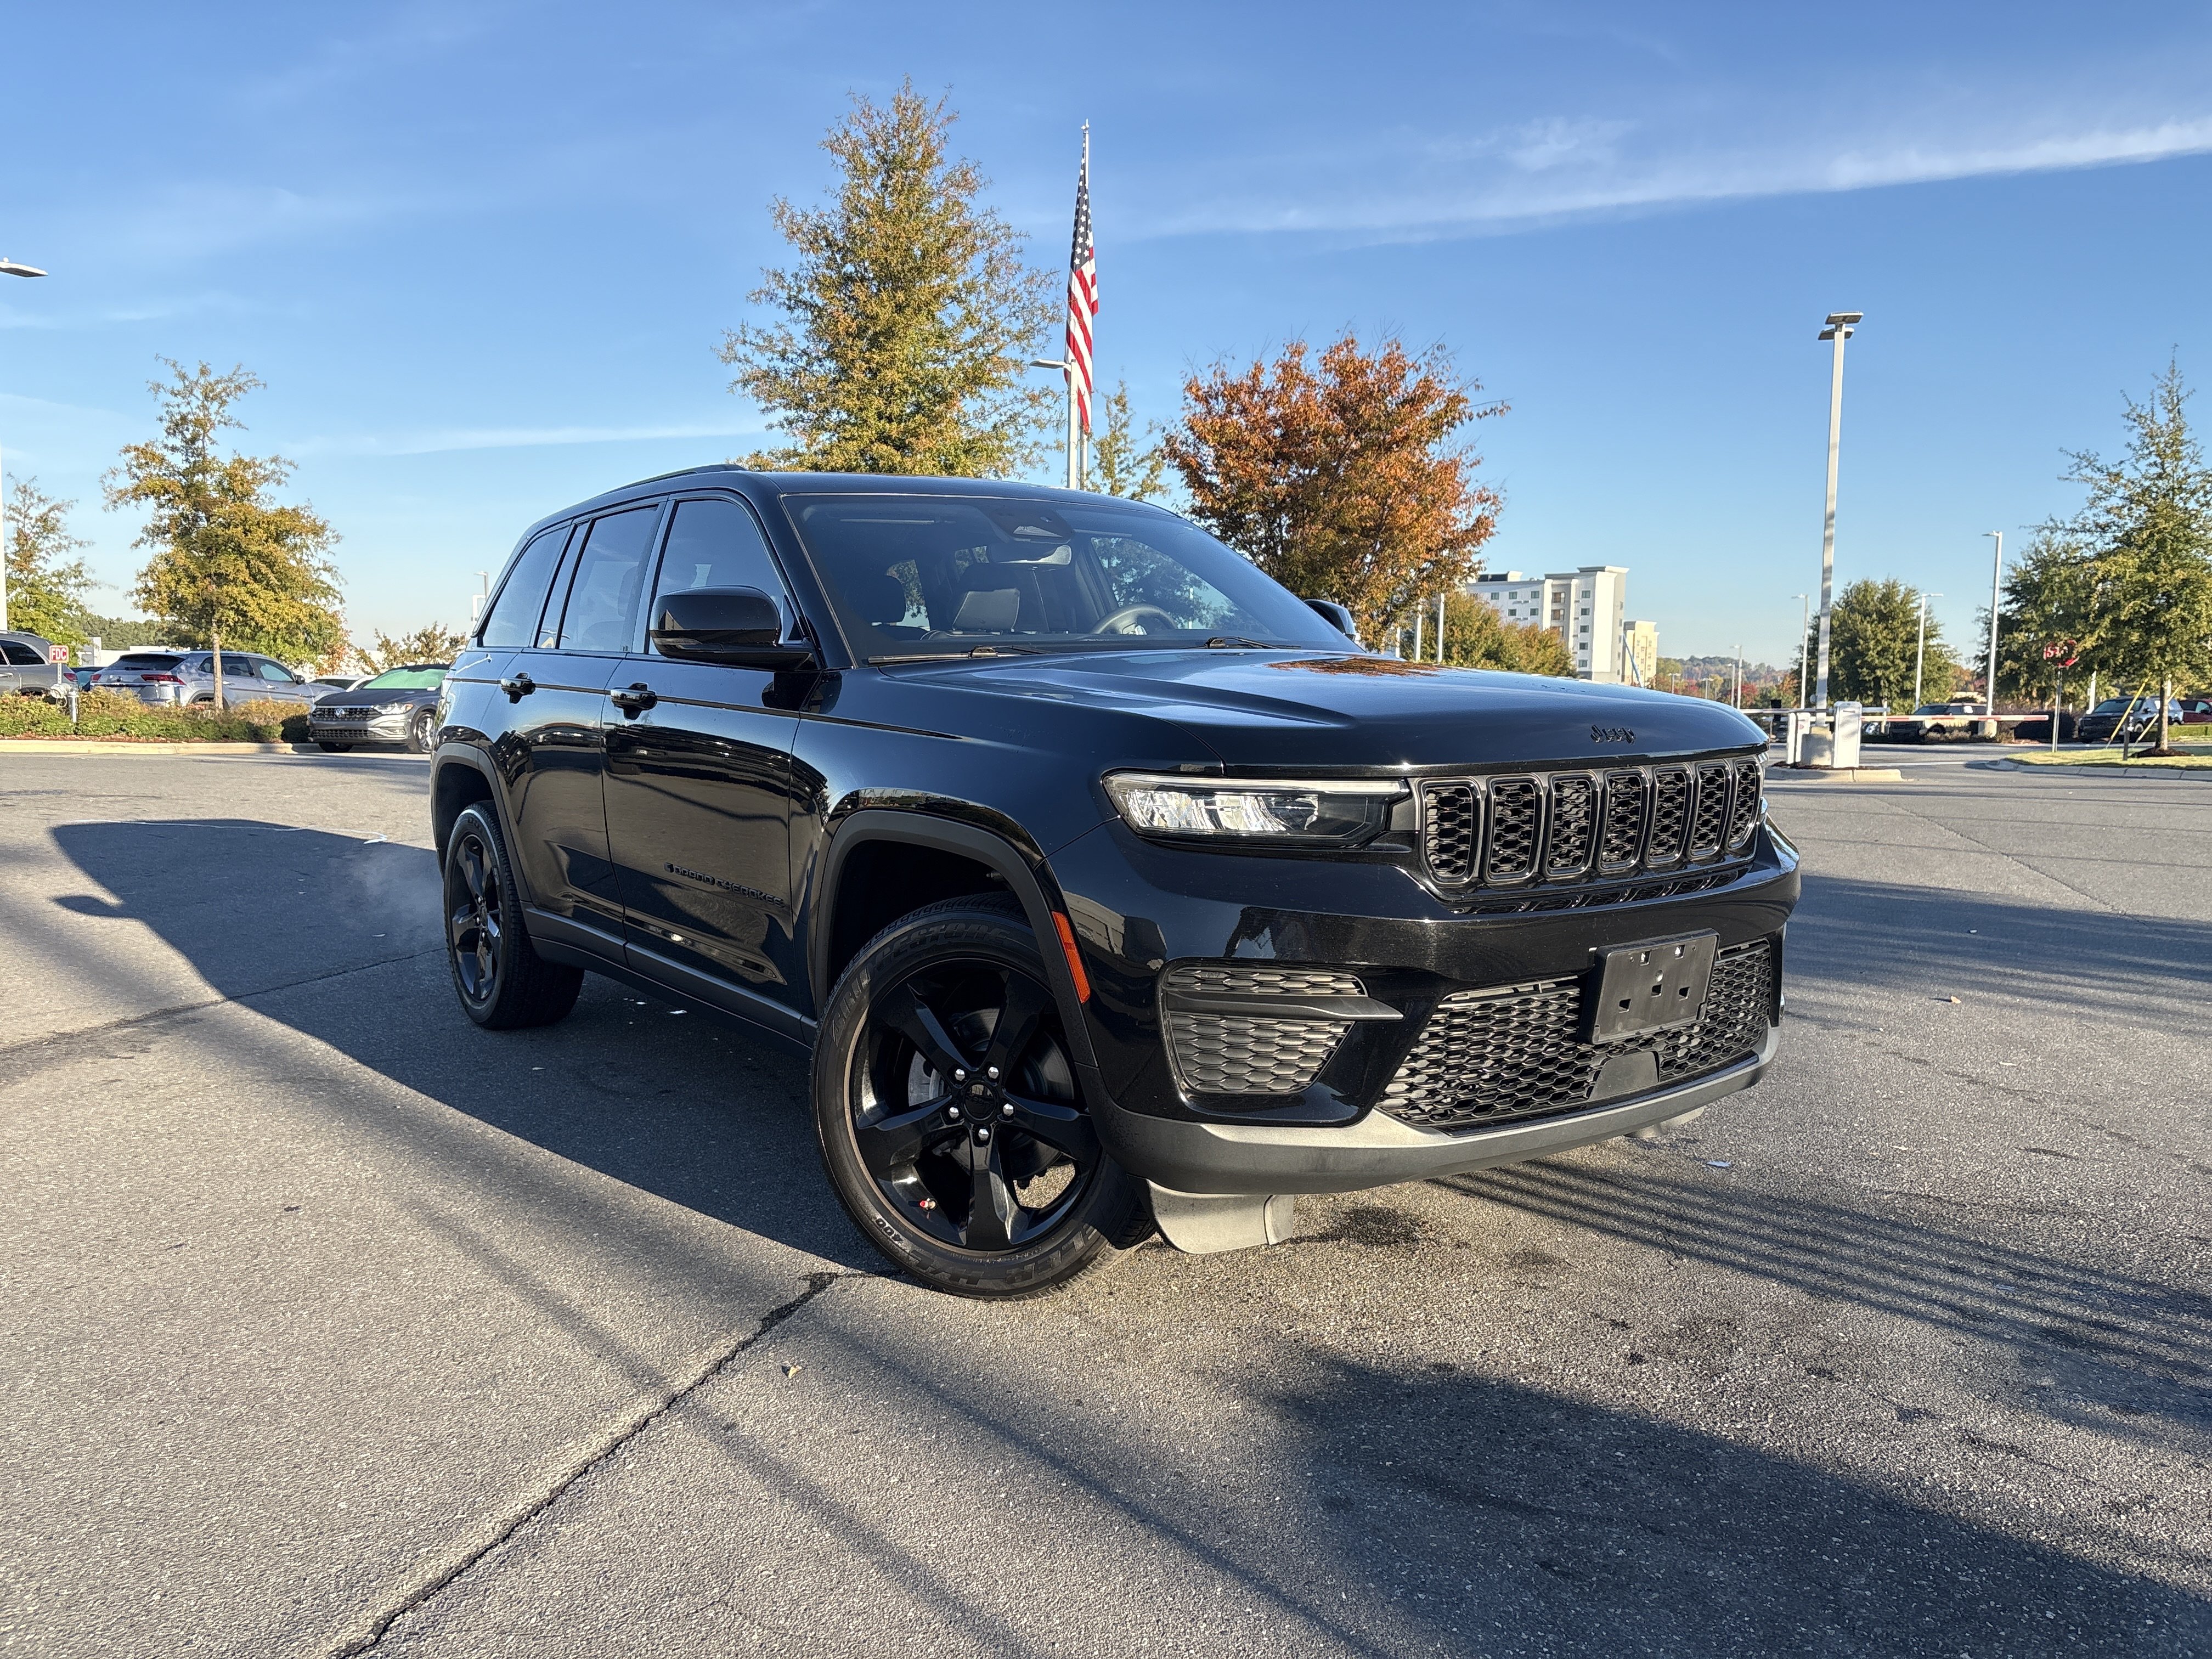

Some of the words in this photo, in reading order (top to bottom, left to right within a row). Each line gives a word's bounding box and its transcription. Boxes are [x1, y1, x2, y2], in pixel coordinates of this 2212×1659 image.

[51, 648, 66, 660] FDC
[1590, 725, 1636, 744] Jeep
[715, 878, 786, 908] CHEROKEE
[828, 922, 1011, 1047] BRIDGESTONE
[875, 1218, 904, 1242] 400
